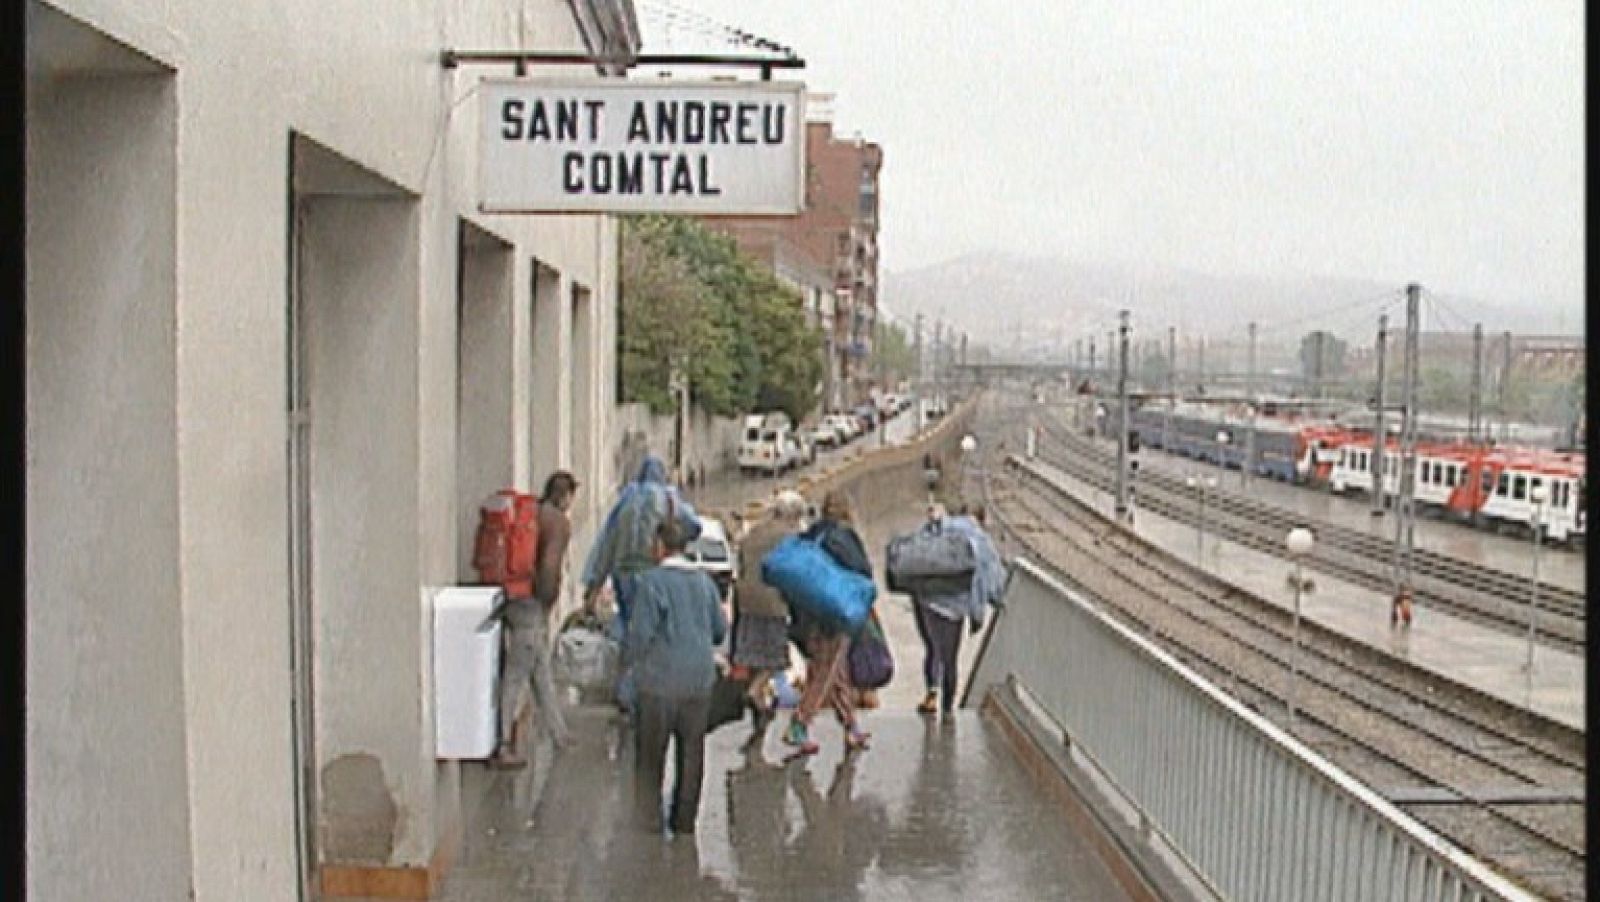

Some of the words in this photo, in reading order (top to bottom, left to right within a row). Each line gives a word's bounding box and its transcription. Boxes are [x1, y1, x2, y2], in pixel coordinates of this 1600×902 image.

[501, 100, 605, 141] SANT
[627, 101, 786, 145] ANDREU
[563, 151, 722, 195] COMTAL
